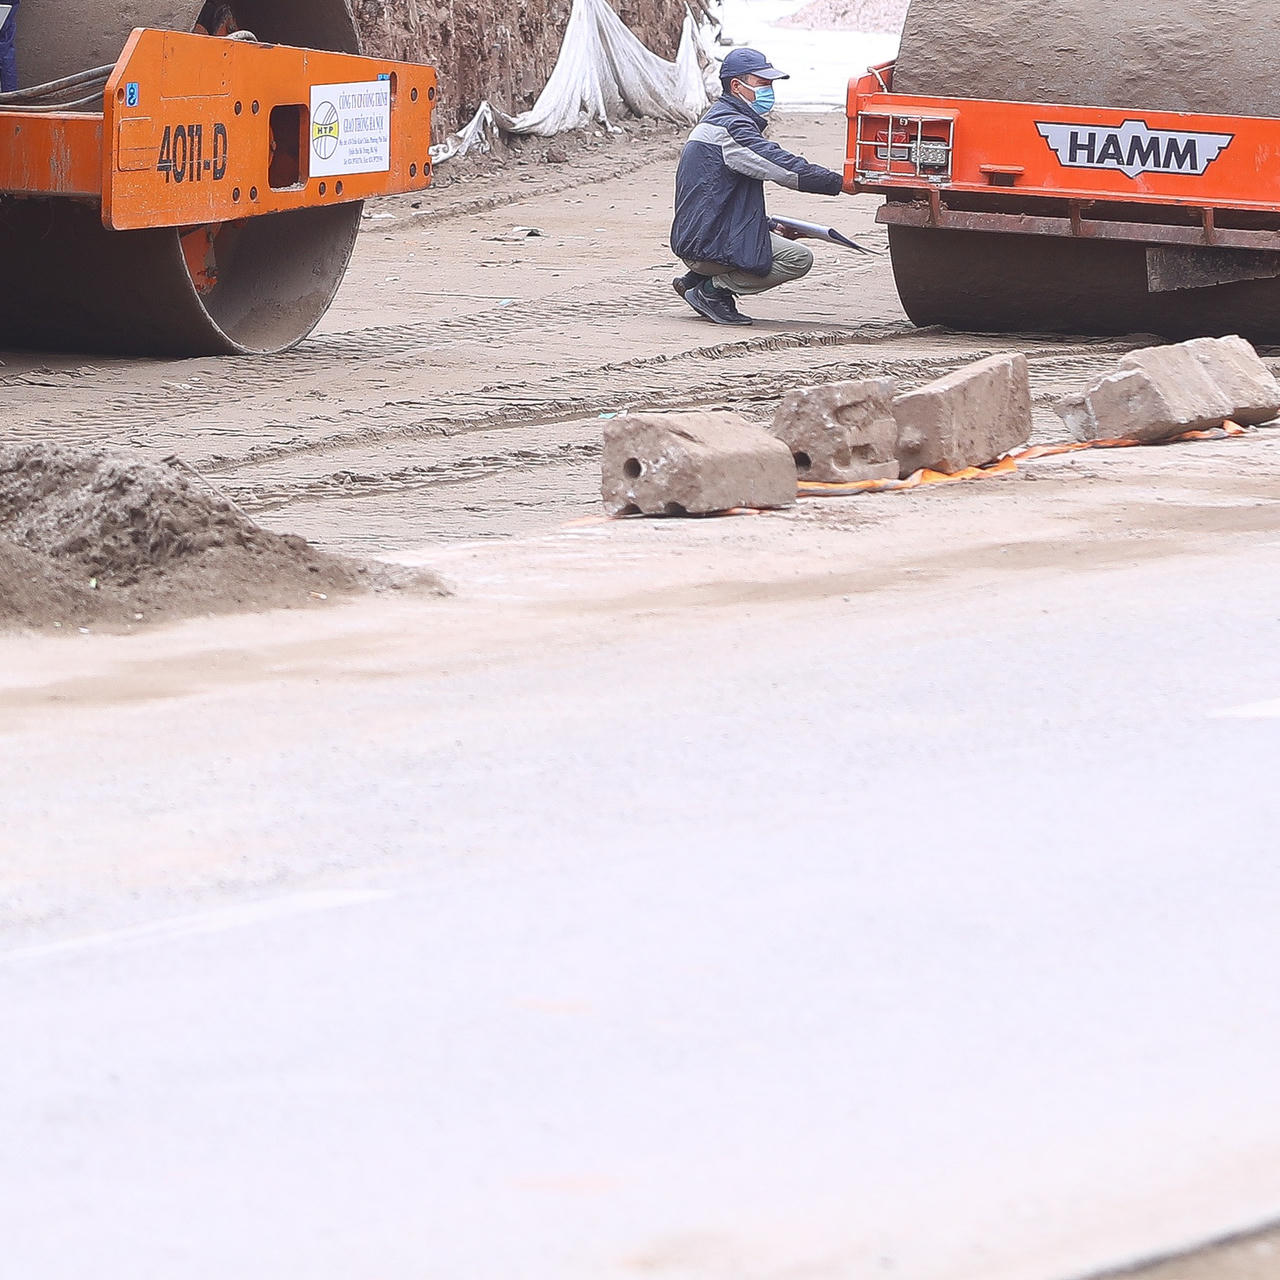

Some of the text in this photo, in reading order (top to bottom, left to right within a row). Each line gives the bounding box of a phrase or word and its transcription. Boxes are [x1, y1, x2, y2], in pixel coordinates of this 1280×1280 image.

[317, 127, 334, 135] HTP
[1068, 131, 1198, 171] HAMM
[157, 123, 228, 184] 4011-D
